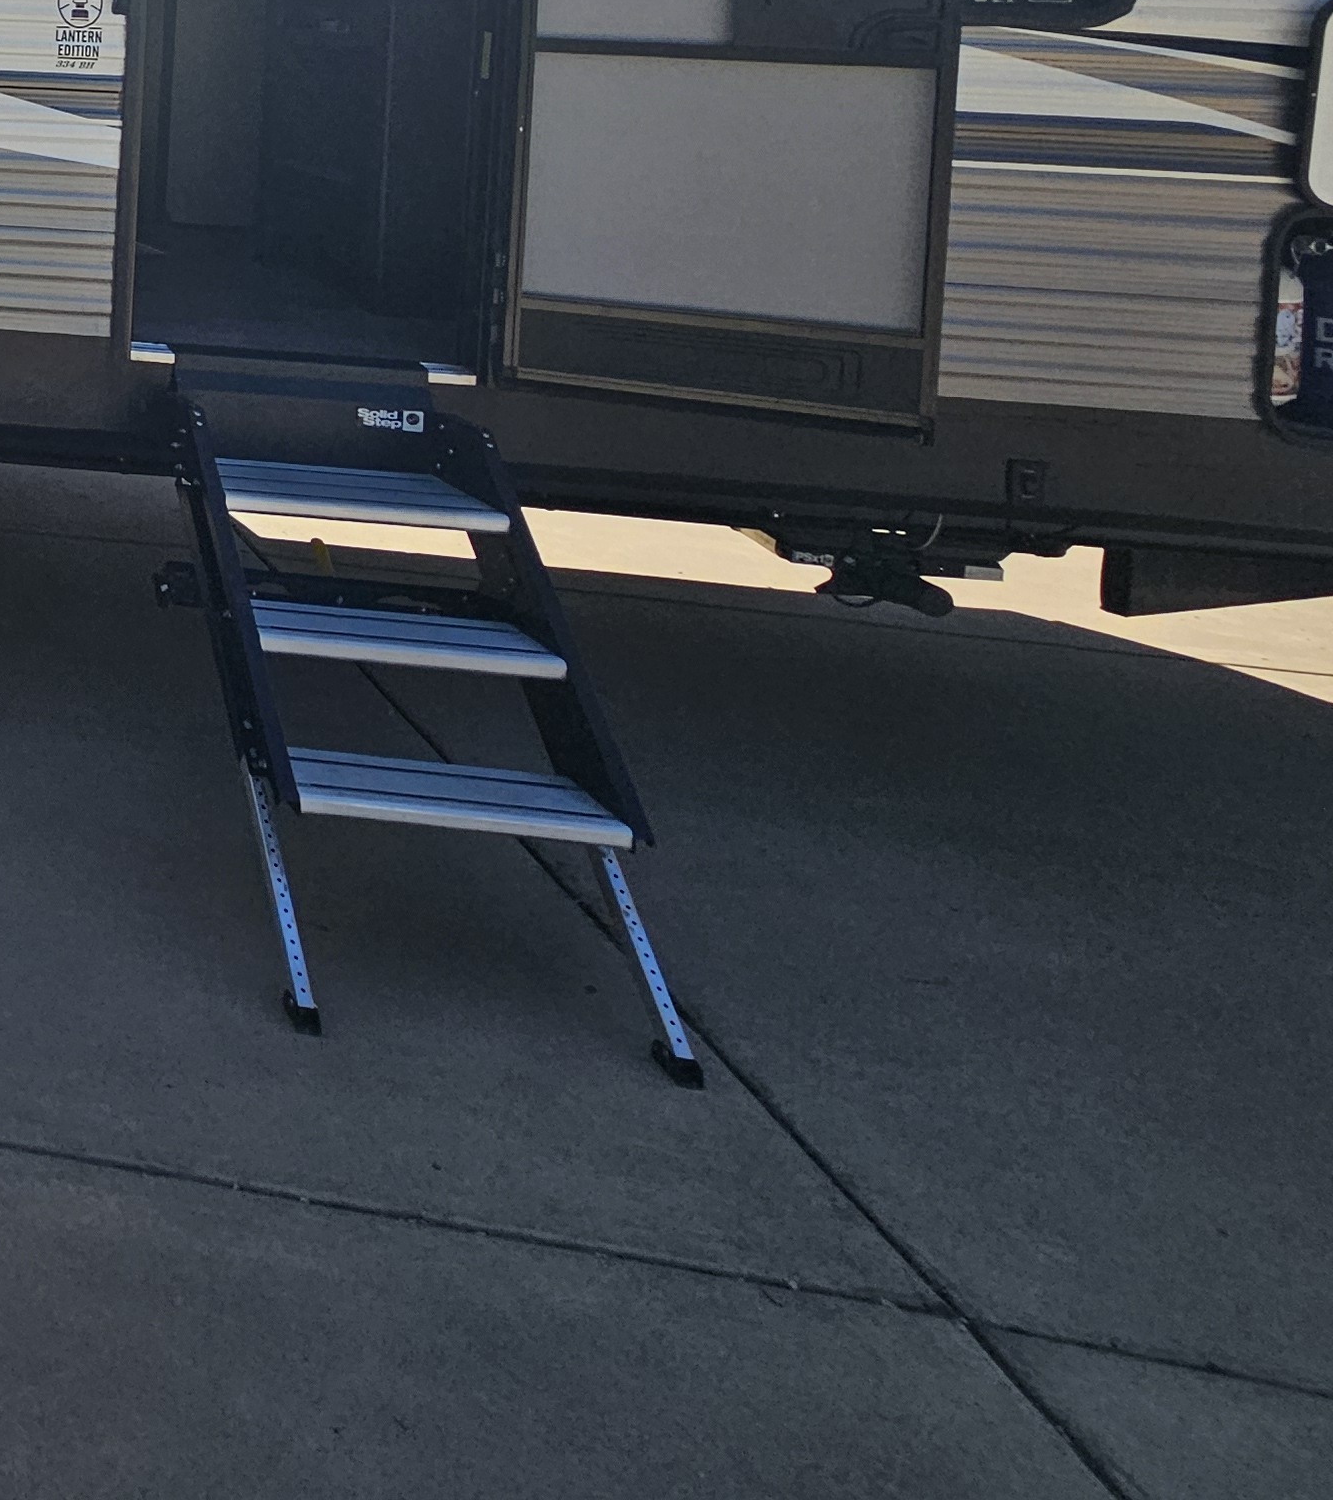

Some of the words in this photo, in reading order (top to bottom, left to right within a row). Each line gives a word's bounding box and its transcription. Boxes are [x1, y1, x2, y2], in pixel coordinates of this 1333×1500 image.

[55, 30, 102, 43] LANTERN
[58, 44, 99, 57] EDITION
[357, 408, 398, 419] Solid
[362, 418, 402, 430] Step
